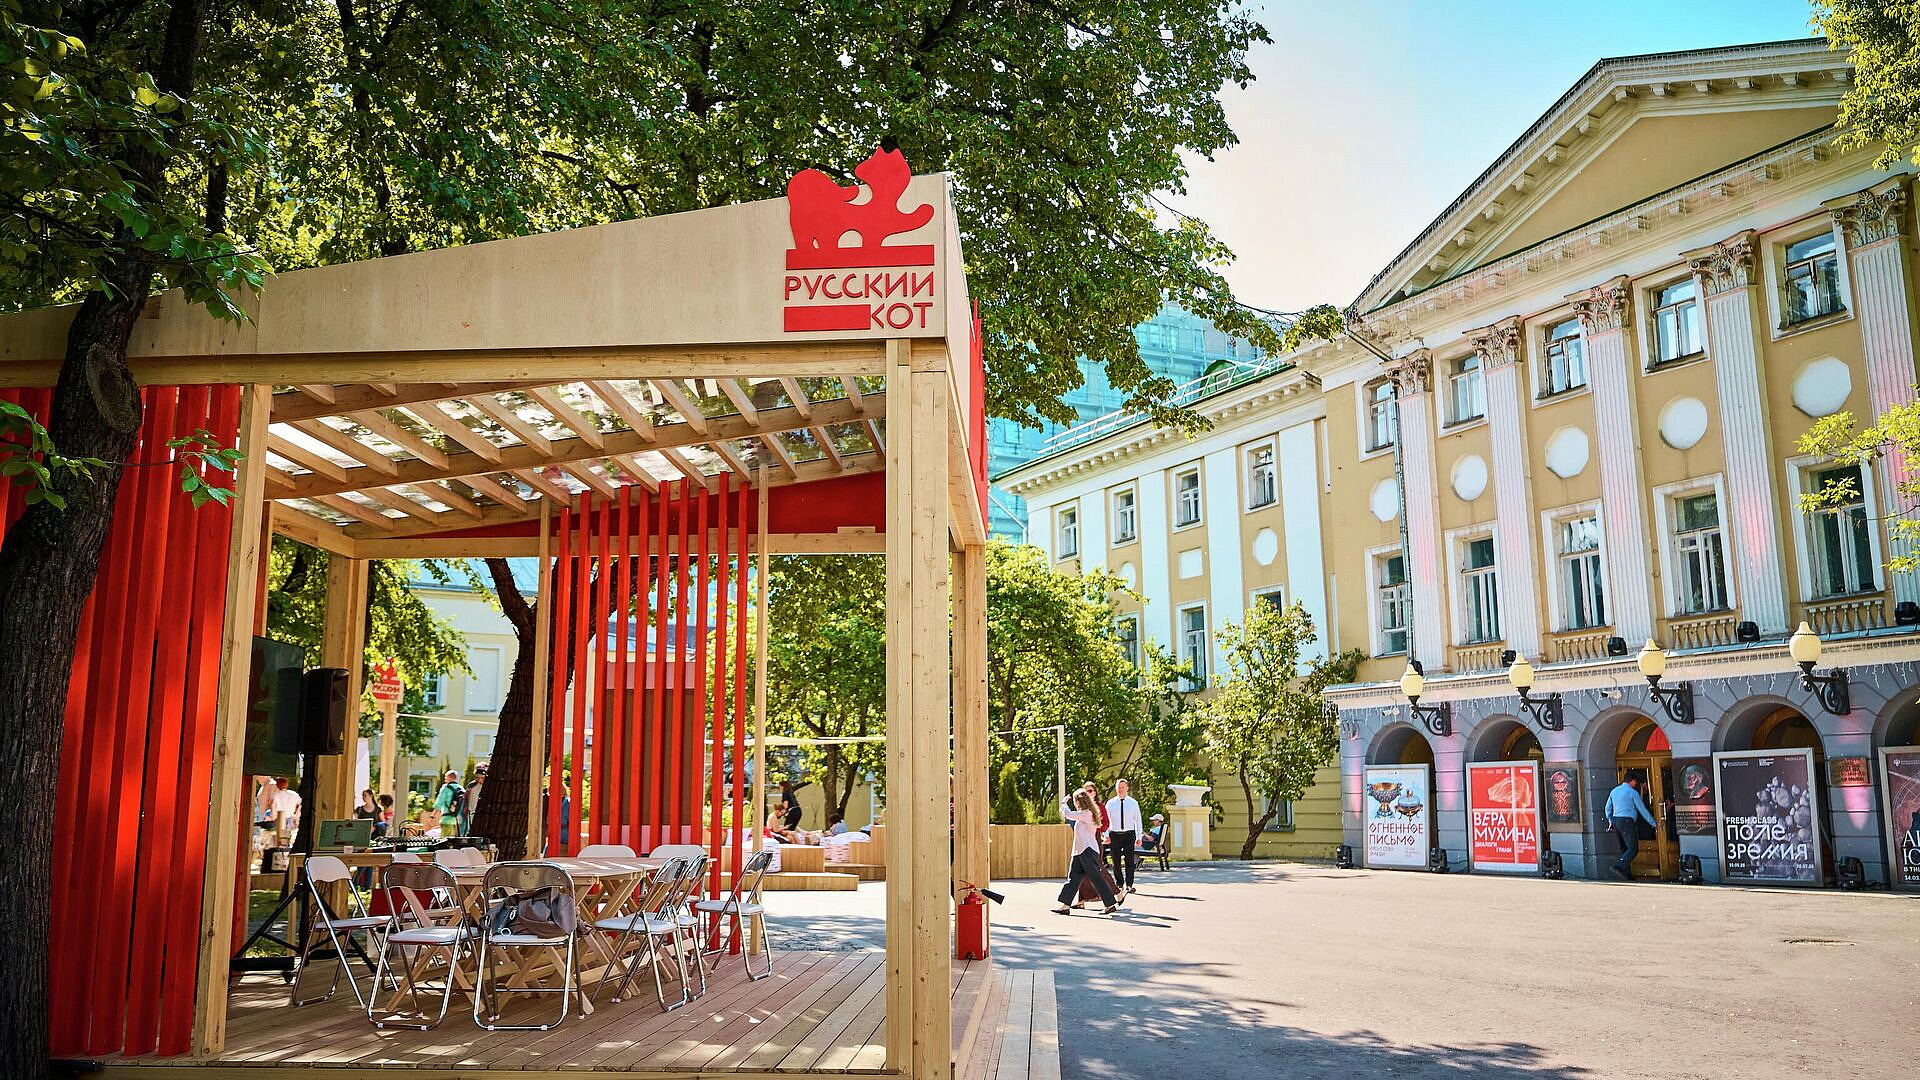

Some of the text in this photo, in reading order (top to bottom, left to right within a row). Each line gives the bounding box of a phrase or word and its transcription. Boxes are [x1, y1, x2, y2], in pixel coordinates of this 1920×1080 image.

[871, 302, 933, 329] КОТ
[1474, 812, 1506, 826] ВЕРА
[1726, 816, 1777, 825] FRESH GLASS
[1369, 823, 1424, 834] ОГНЕННОЕ
[1474, 827, 1535, 841] МУХИНА
[1369, 835, 1415, 845] ПИСЬМО
